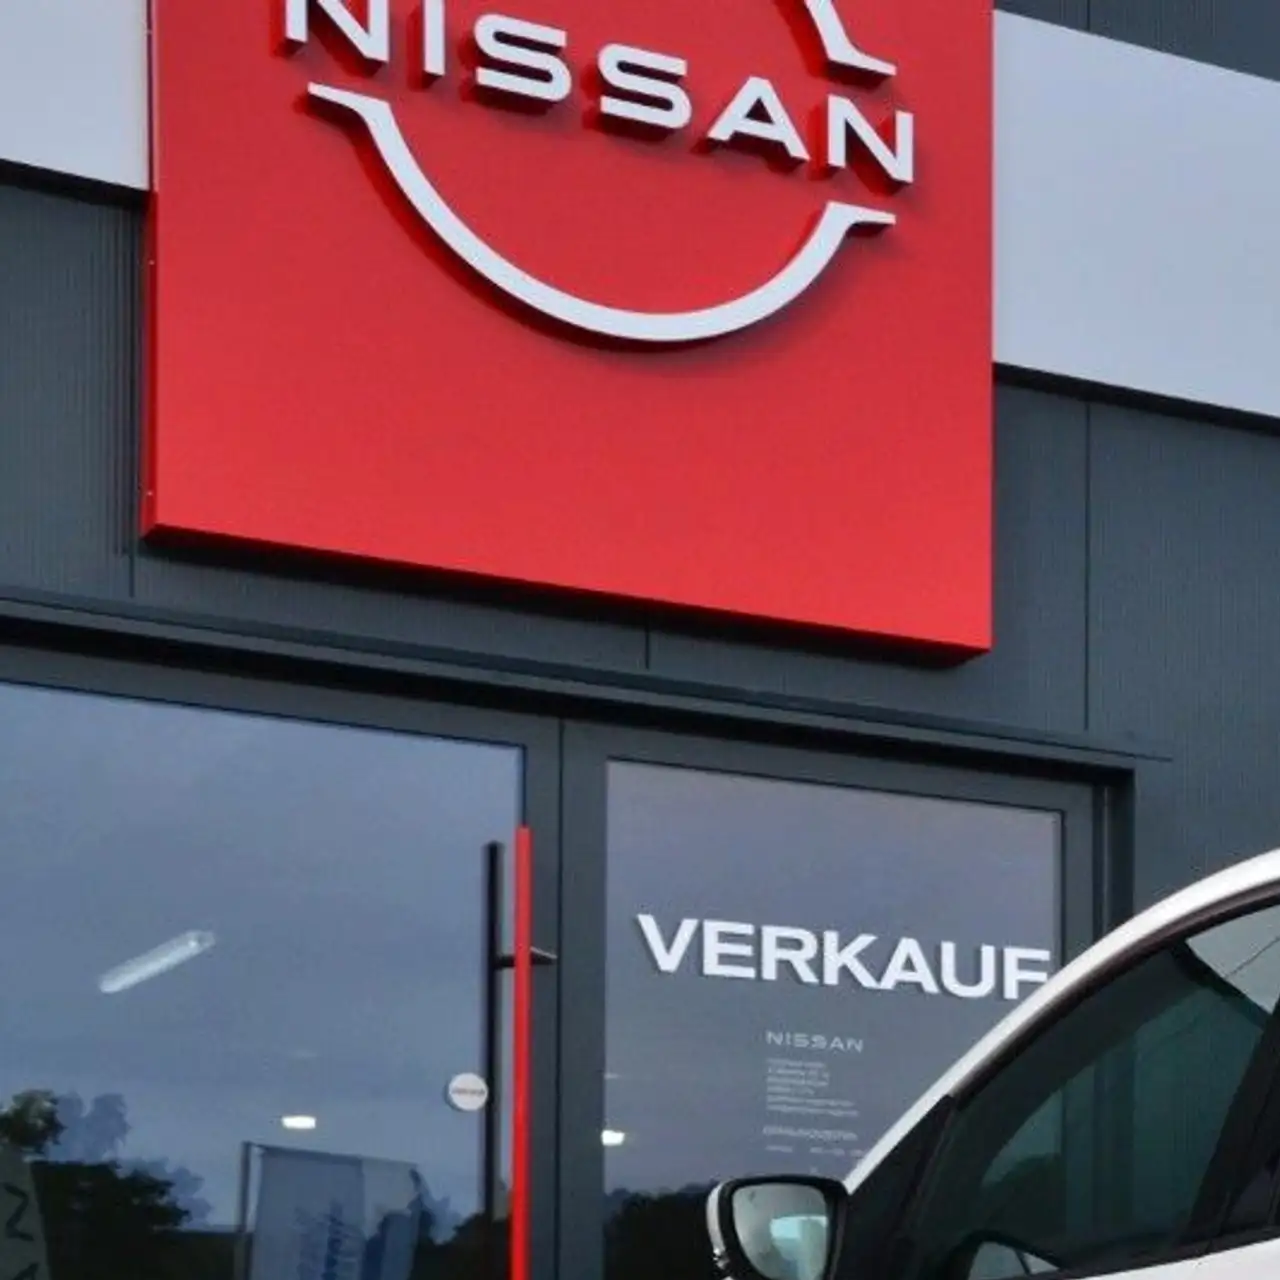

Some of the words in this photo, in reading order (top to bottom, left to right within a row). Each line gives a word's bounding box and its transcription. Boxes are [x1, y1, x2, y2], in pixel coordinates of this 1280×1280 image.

[284, 0, 914, 184] NISSAN
[637, 913, 1050, 1000] VERKAUF
[765, 1030, 864, 1053] NISSAN
